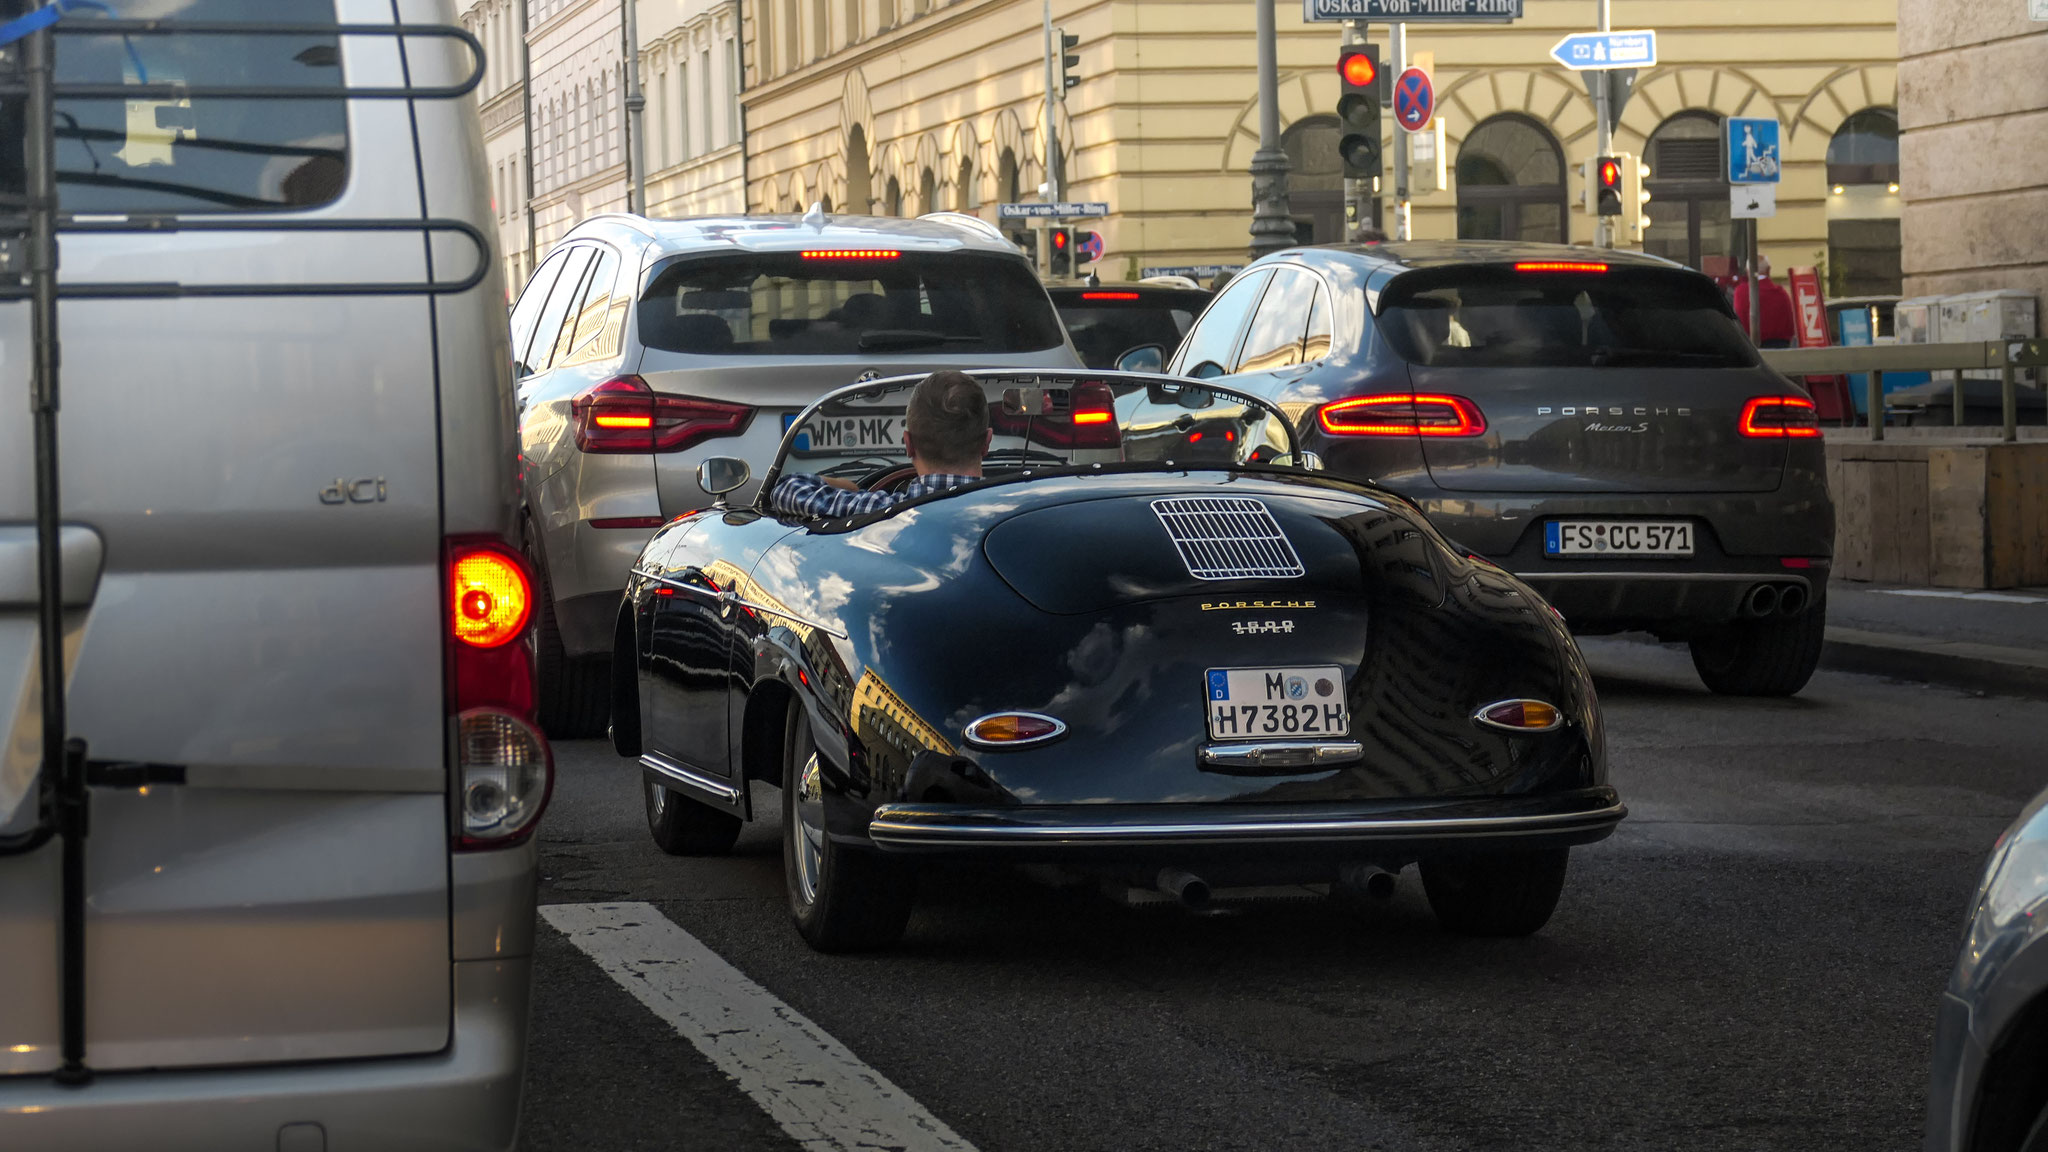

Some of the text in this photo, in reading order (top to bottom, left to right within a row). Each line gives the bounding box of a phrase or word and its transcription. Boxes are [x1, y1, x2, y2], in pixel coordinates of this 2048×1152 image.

[1003, 204, 1106, 217] Oskar-von-Miller-Ring
[1537, 406, 1691, 416] PORSCHE
[811, 420, 842, 446] WM
[859, 418, 893, 445] MK
[1584, 422, 1649, 433] Macan S
[1561, 524, 1691, 550] FS CC 571
[1201, 600, 1316, 610] PORSCHE
[1265, 672, 1285, 700] M
[1215, 689, 1224, 699] D
[1217, 703, 1344, 734] H7382H
